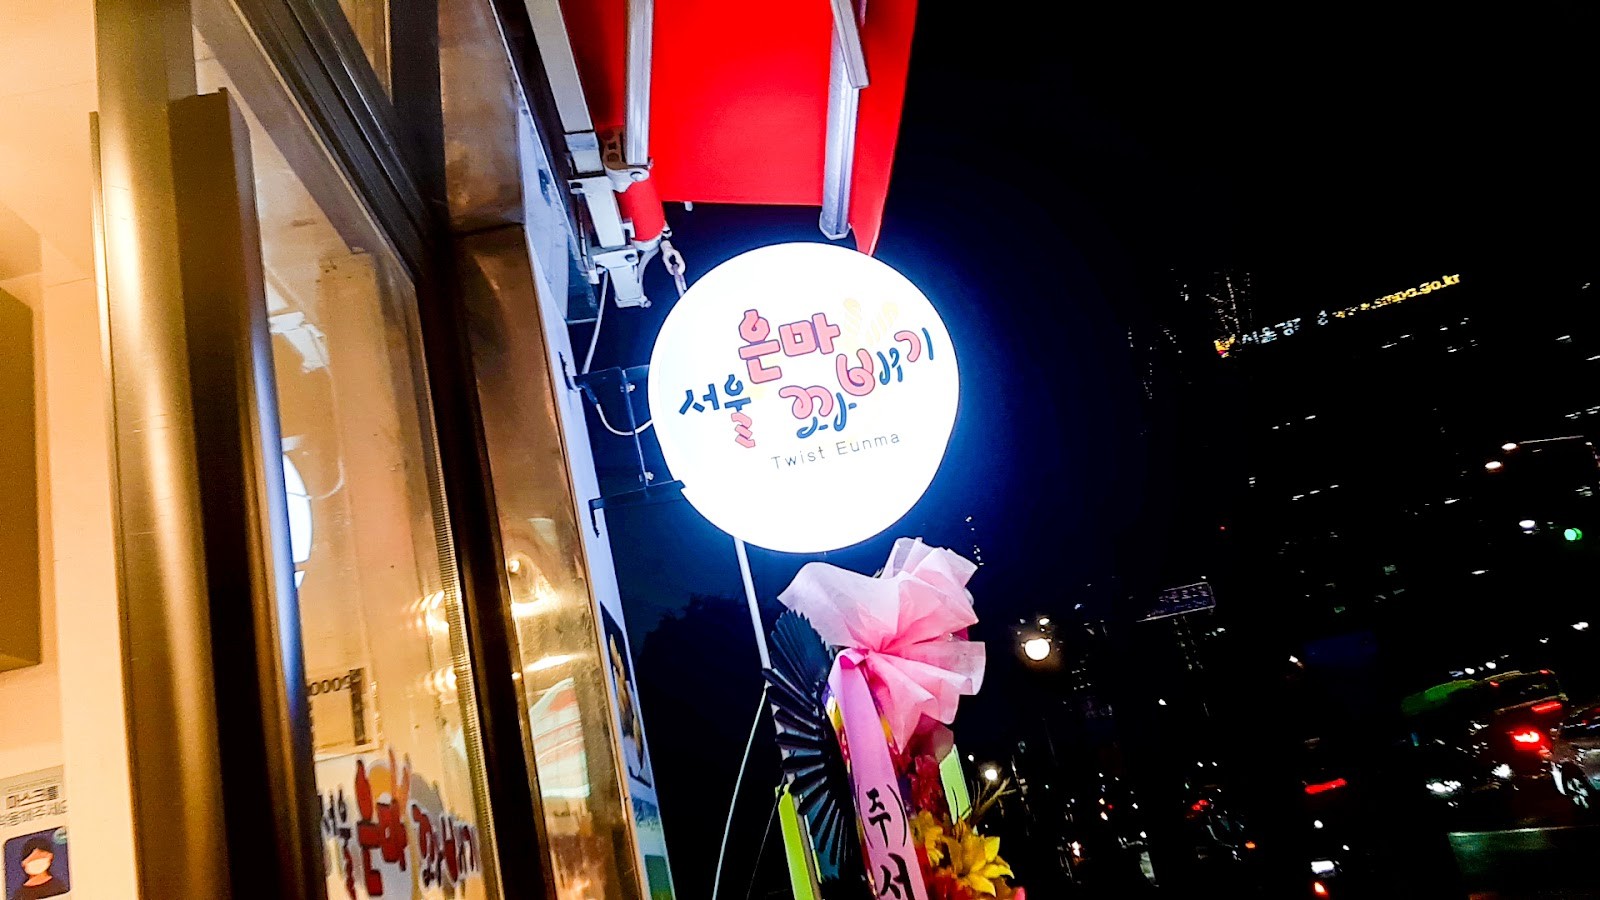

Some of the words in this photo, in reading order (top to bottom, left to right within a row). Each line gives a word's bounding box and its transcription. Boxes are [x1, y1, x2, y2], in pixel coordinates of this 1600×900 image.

[738, 308, 841, 385] 은마
[778, 327, 934, 439] 꽈배기
[679, 374, 756, 449] 서울
[771, 446, 825, 469] Twist
[835, 433, 900, 455] Eunma
[355, 759, 406, 897] 은마
